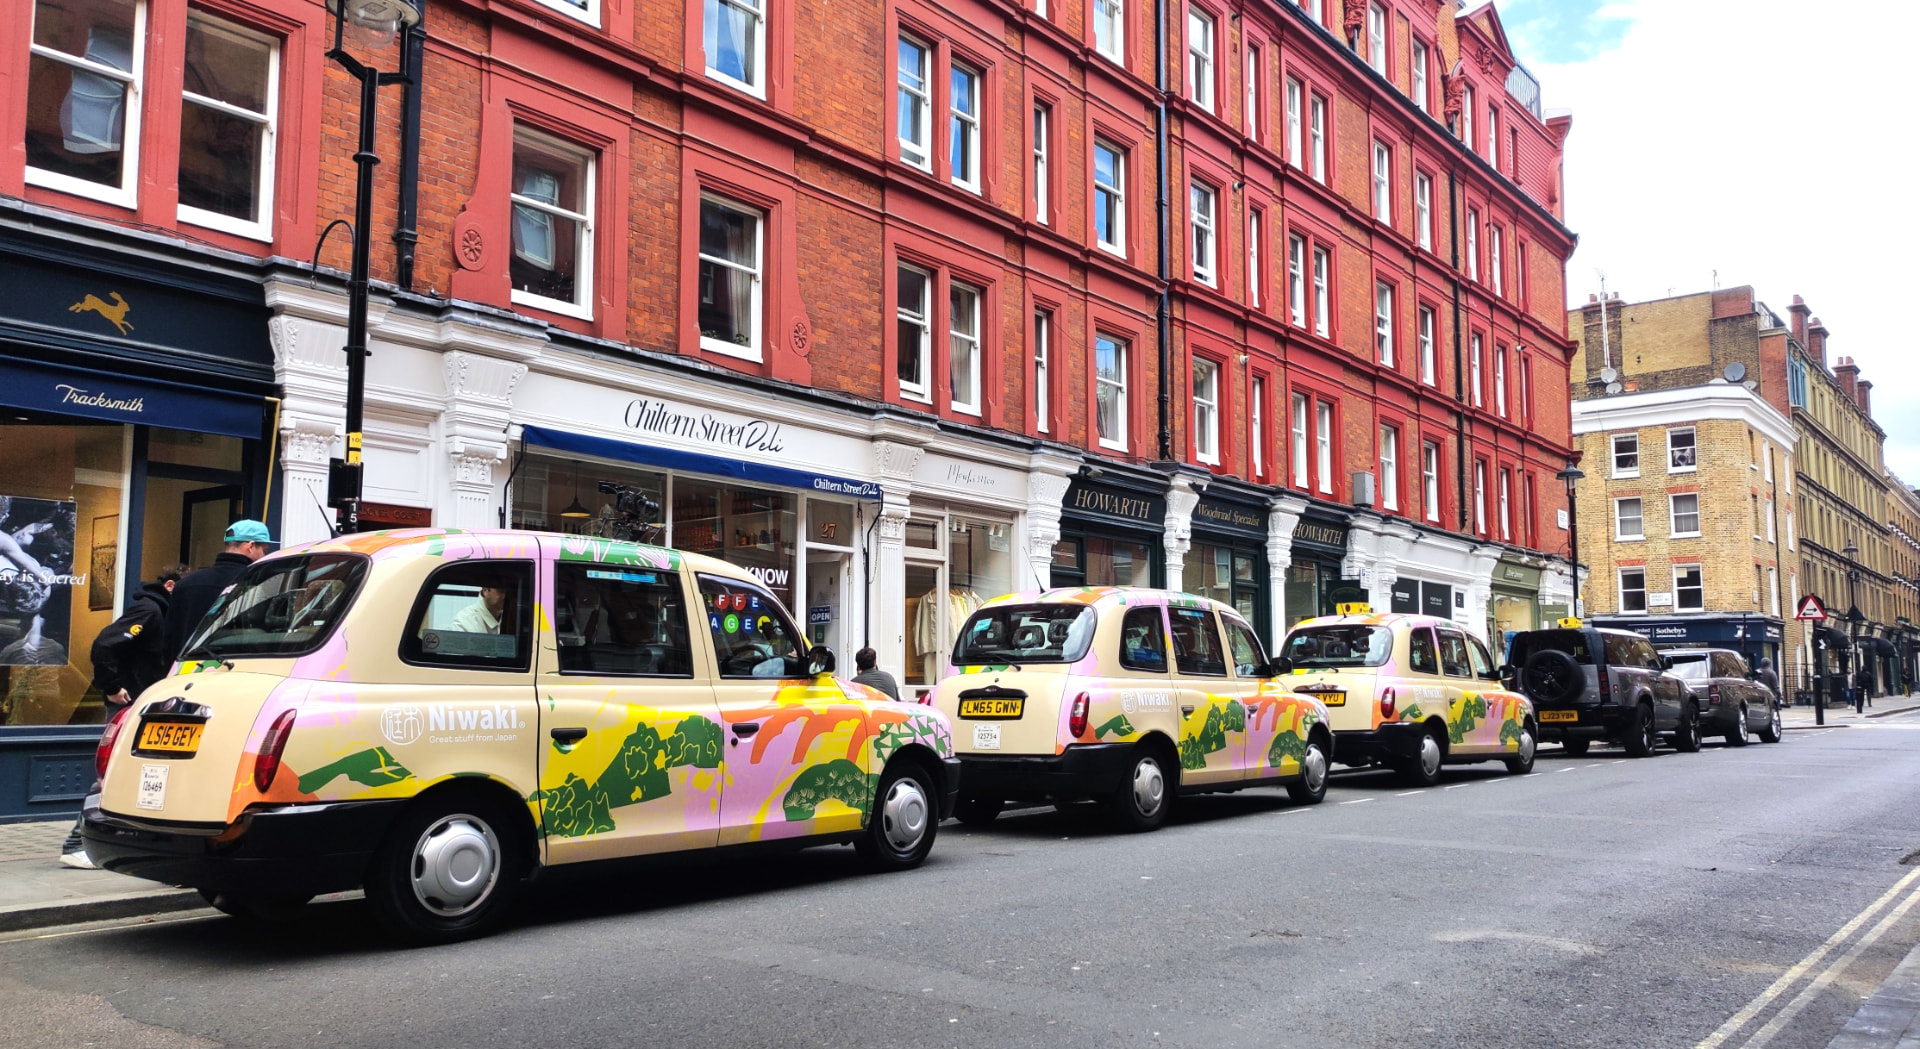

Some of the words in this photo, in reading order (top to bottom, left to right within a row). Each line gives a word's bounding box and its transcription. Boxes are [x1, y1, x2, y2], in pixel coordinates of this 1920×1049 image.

[55, 384, 144, 412] Tracksmith
[624, 399, 696, 438] Chiltern
[695, 413, 746, 447] Street
[745, 420, 784, 453] Deli
[814, 478, 842, 492] Chiltern
[842, 482, 863, 495] Street
[861, 483, 878, 495] Deli
[1074, 489, 1151, 519] HOWARTH
[821, 522, 837, 539] 27
[1294, 523, 1342, 545] HOWARTH
[0, 571, 13, 585] ay
[21, 569, 34, 583] is
[39, 569, 87, 586] Sacred
[811, 613, 830, 622] OPEN
[1656, 626, 1687, 635] Sotheby's
[1323, 693, 1340, 702] VYU
[966, 701, 993, 714] LM65
[995, 701, 1018, 714] GWN
[428, 704, 518, 732] Niwaki
[146, 725, 174, 746] LS15
[172, 725, 198, 747] GEY
[429, 735, 452, 744] Great
[455, 734, 474, 743] stuff
[476, 733, 494, 742] from
[495, 733, 518, 743] Japan
